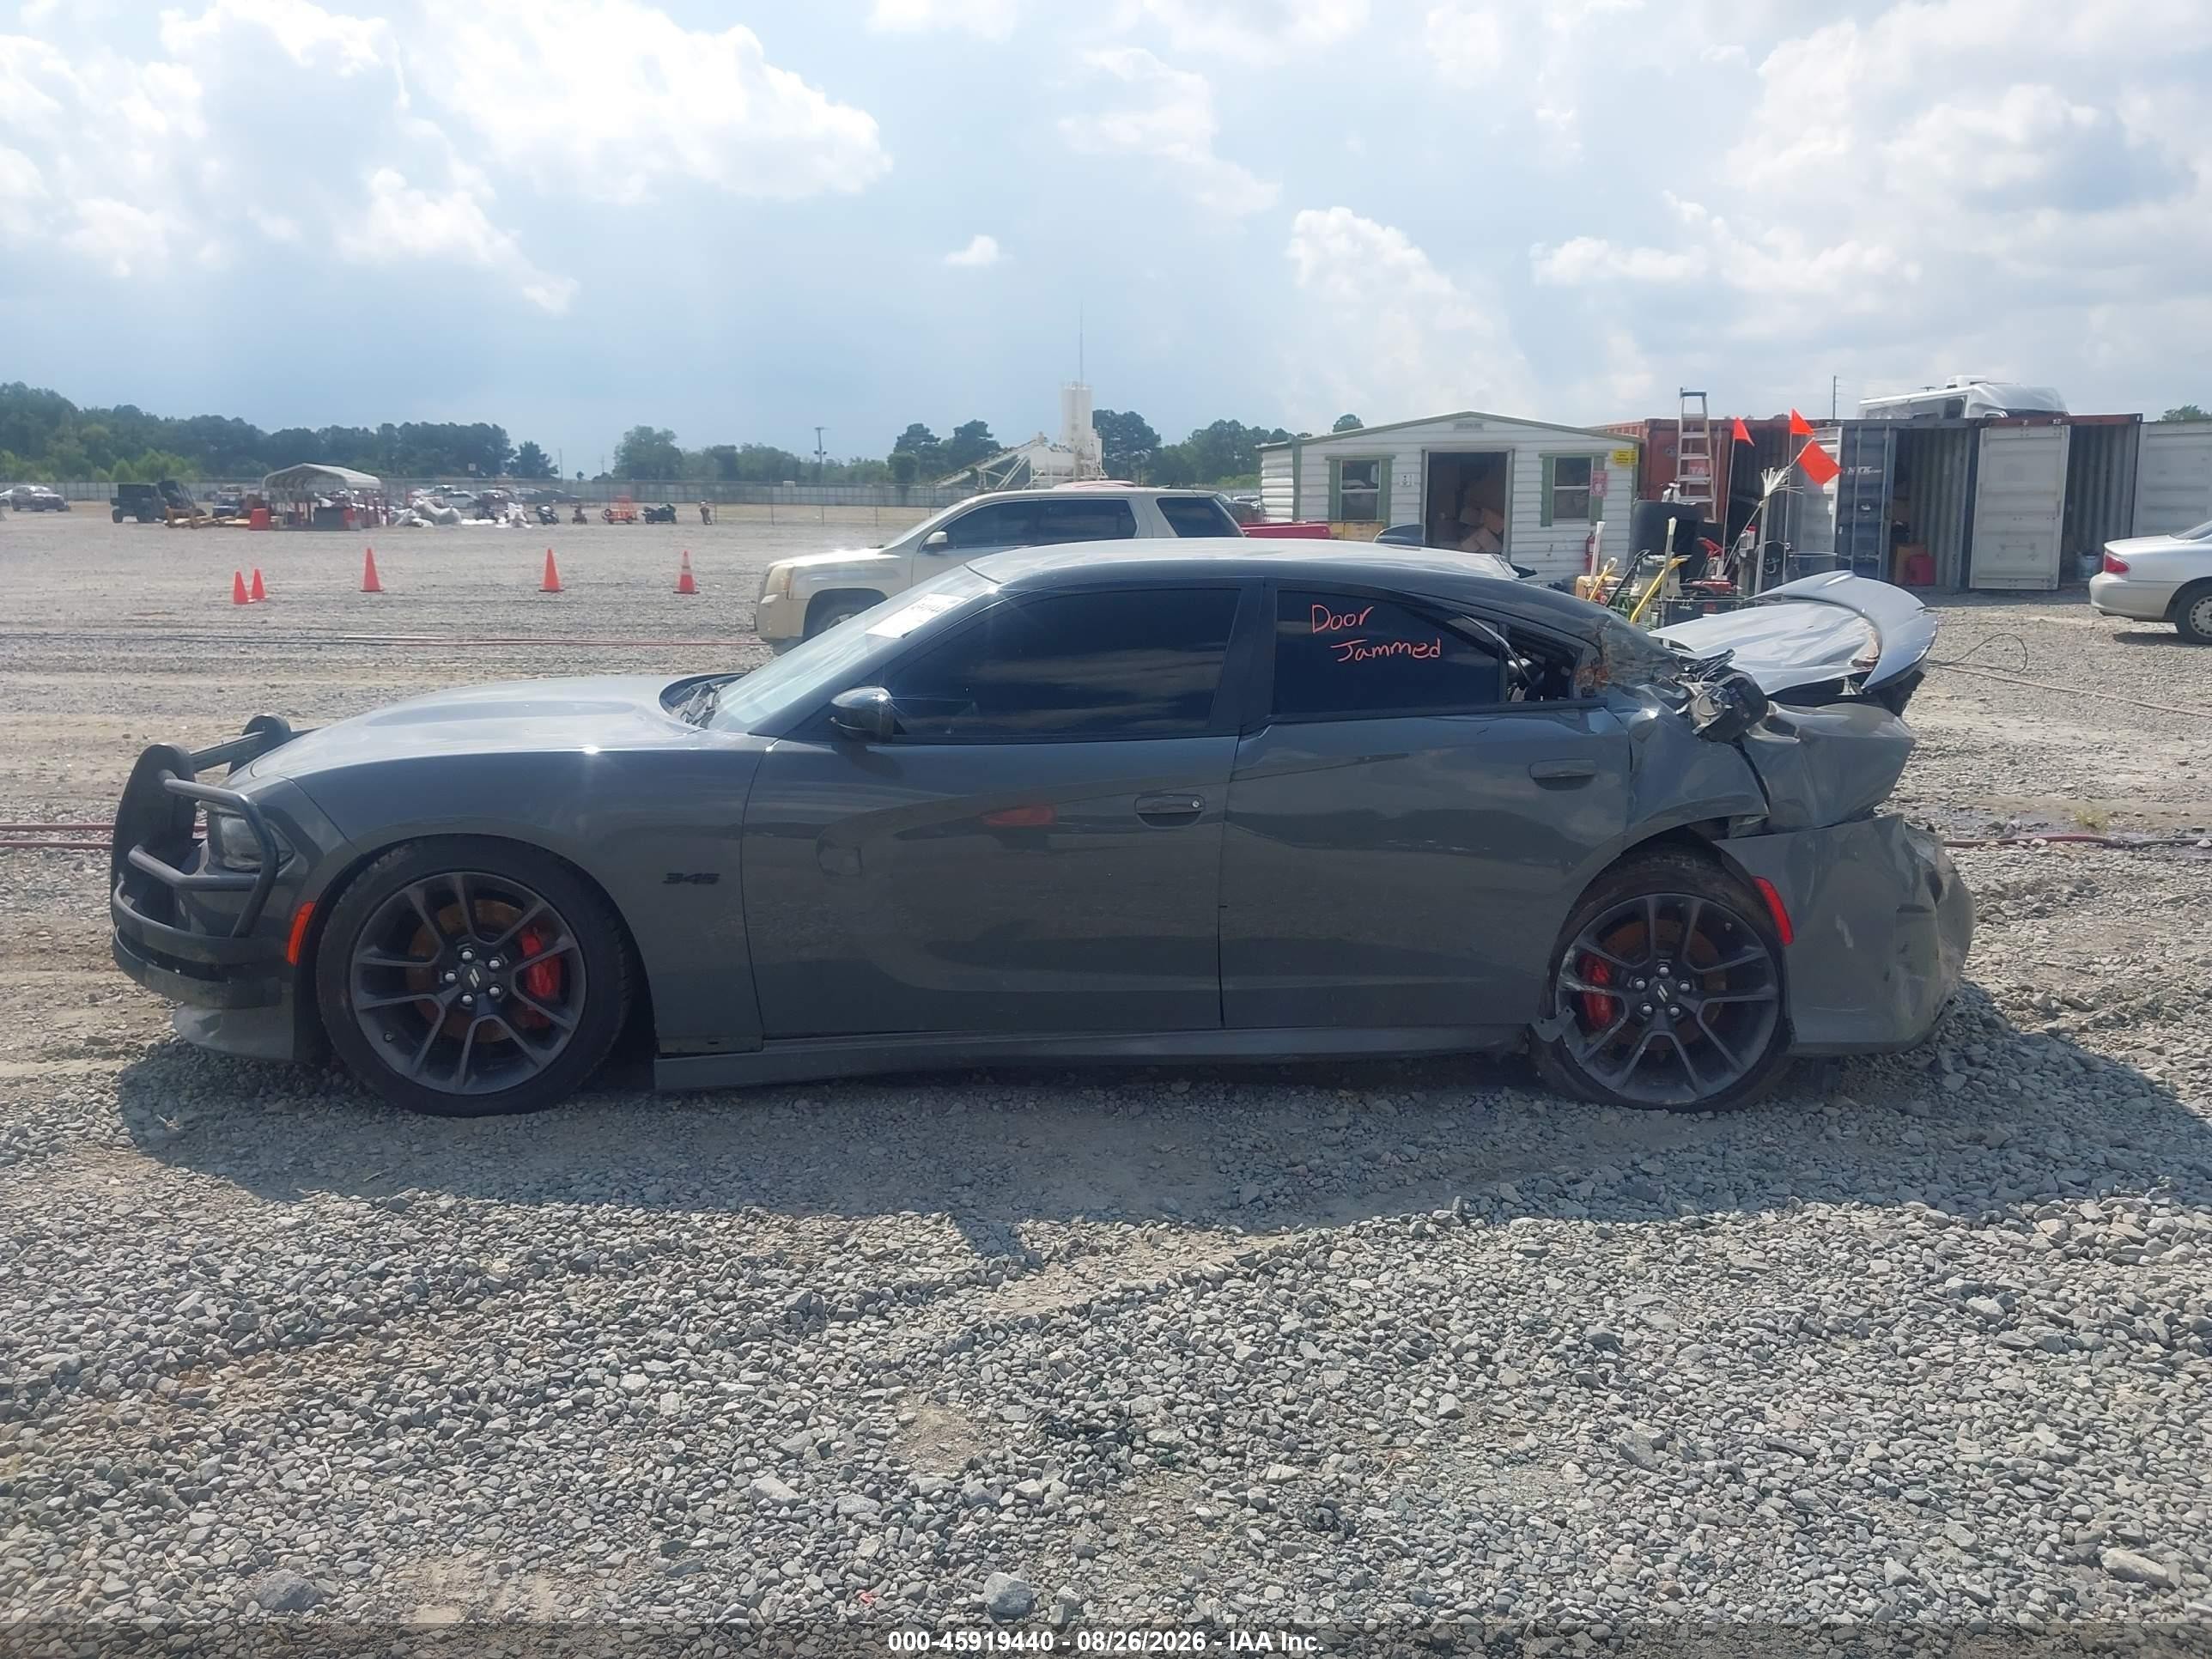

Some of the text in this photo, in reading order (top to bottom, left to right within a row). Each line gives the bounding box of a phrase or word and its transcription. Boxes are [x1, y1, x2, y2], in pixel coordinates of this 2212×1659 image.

[1311, 604, 1374, 634] Door
[1330, 638, 1442, 663] Jammed
[662, 872, 720, 885] 345
